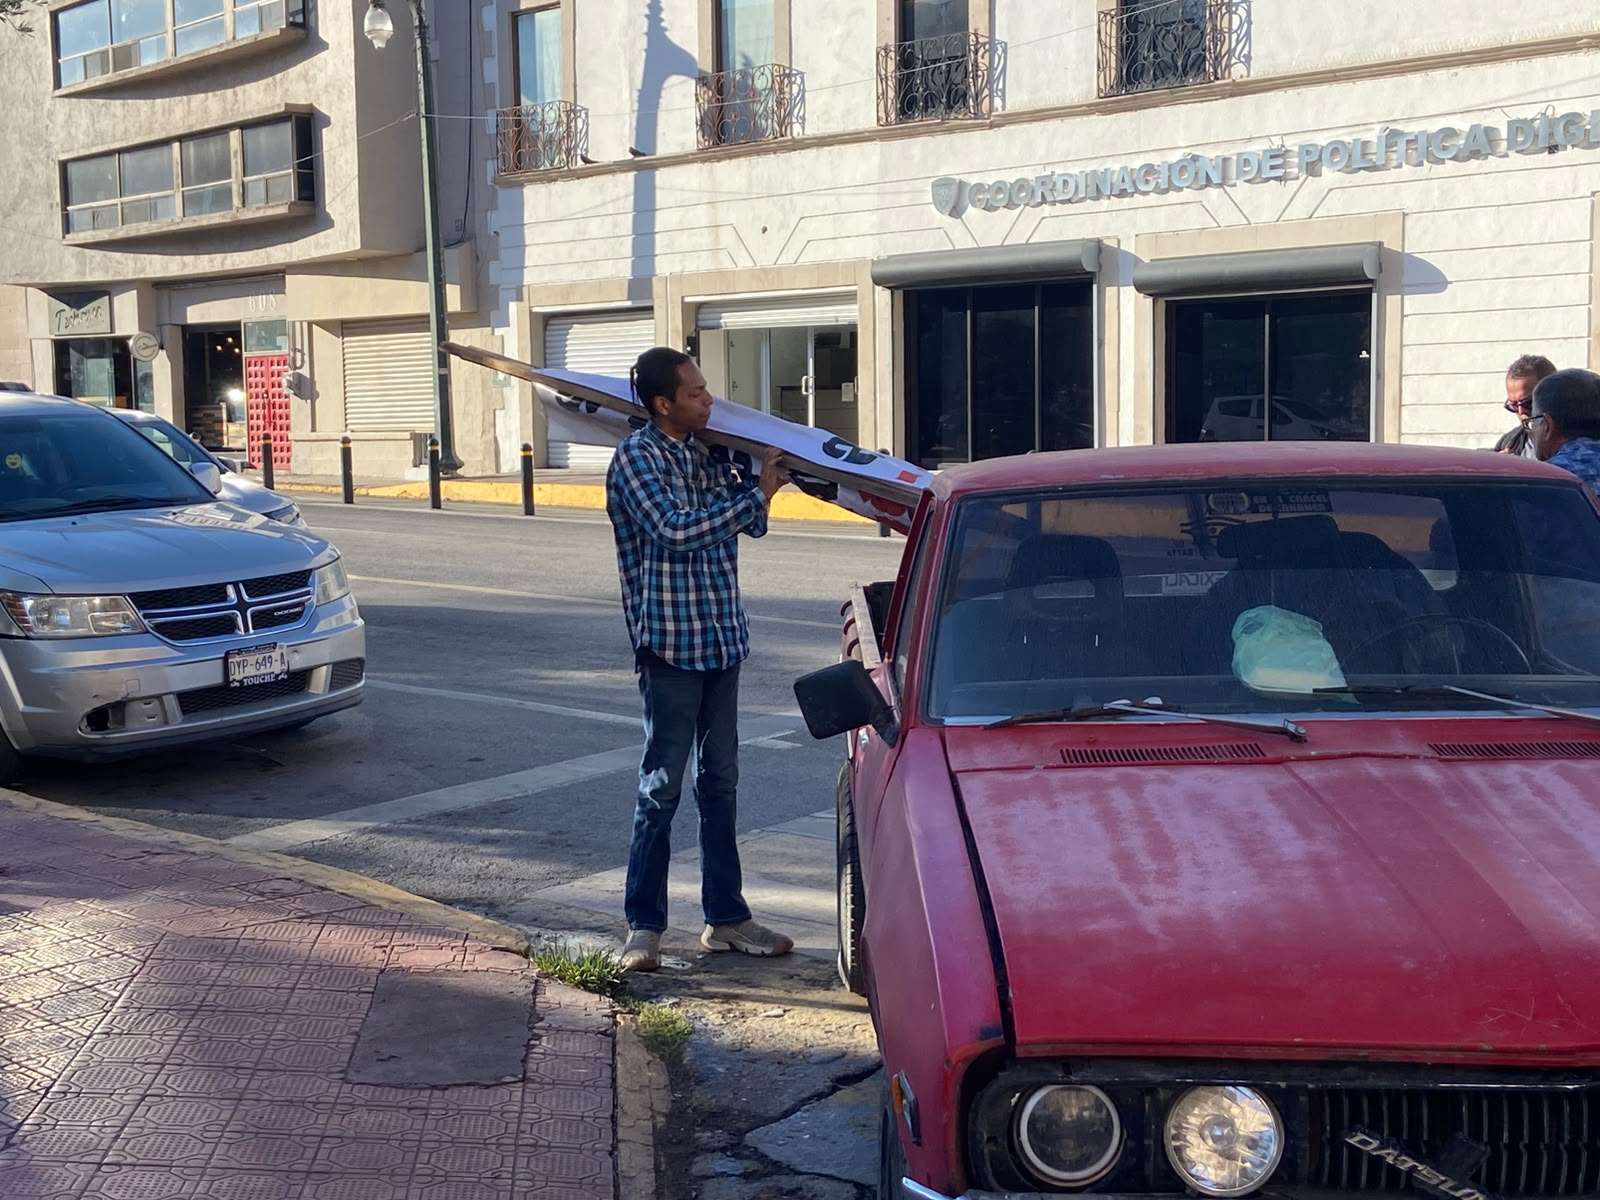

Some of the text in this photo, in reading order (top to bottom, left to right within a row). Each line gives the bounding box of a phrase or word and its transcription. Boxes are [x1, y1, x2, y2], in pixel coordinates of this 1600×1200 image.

[967, 152, 1224, 210] COORDINACIÓN
[1236, 149, 1283, 179] DE
[1298, 123, 1492, 175] POLÍTICA
